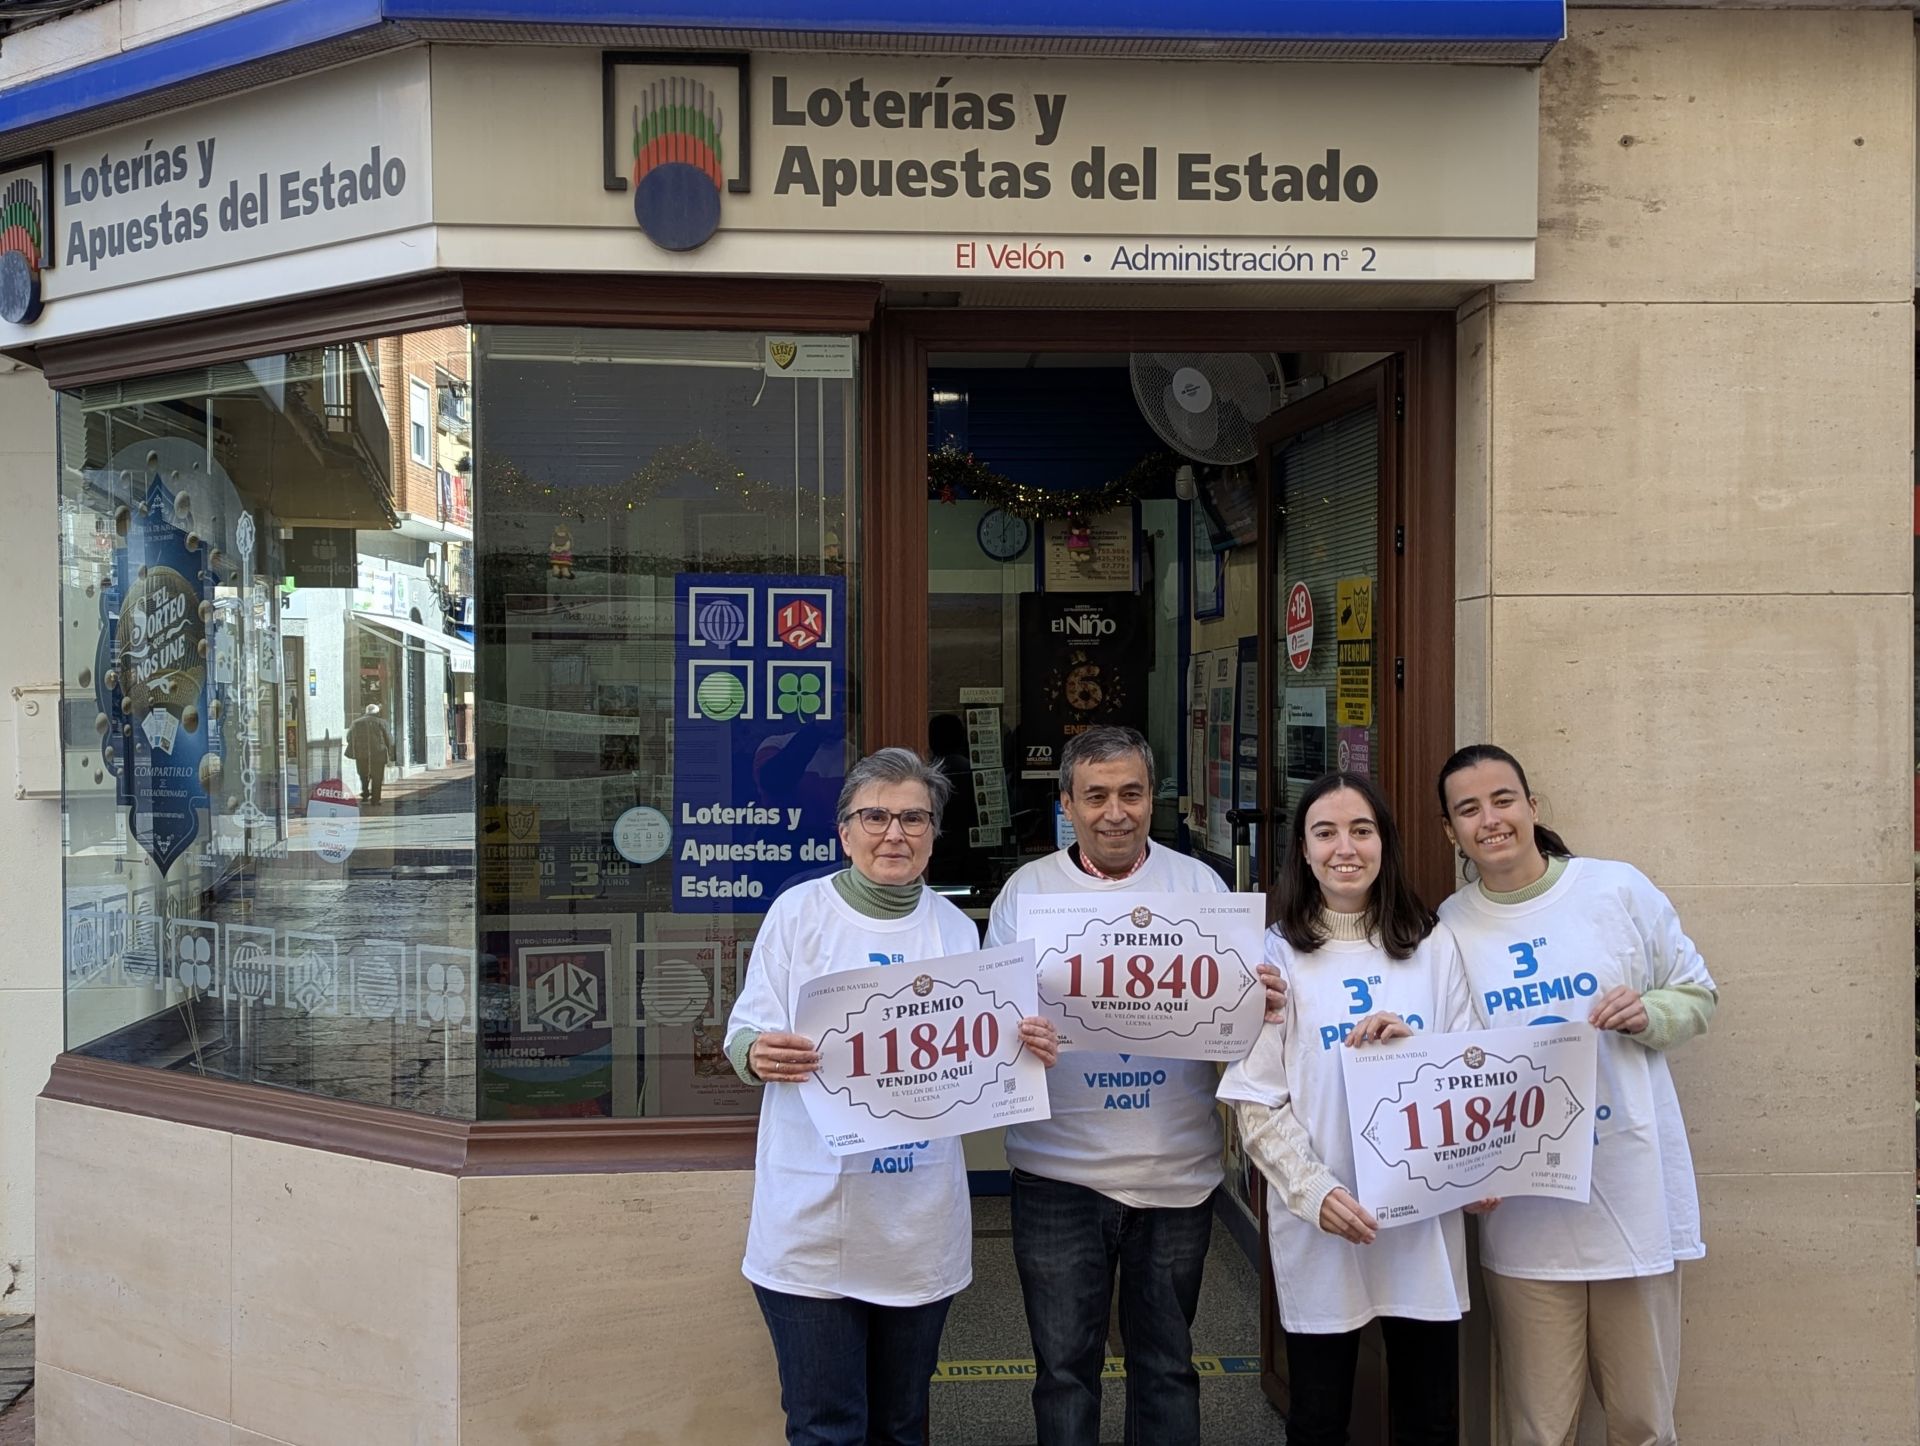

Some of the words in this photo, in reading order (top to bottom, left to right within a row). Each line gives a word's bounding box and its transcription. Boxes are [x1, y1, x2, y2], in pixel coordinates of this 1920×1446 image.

[771, 76, 1016, 130] Loterías
[1033, 94, 1067, 146] y
[63, 138, 188, 207] Loterías
[196, 136, 216, 189] y
[774, 145, 1052, 208] Apuestas
[1071, 146, 1157, 201] del
[1177, 149, 1379, 204] Estado
[65, 199, 209, 272] Apuestas
[218, 172, 269, 232] del
[279, 144, 406, 220] Estado
[956, 242, 976, 269] El
[987, 242, 1065, 270] Velón
[1110, 244, 1314, 273] Administración
[1361, 247, 1377, 272] 2
[771, 344, 793, 356] LEYSE
[152, 585, 169, 608] EL
[1291, 590, 1307, 620] +18
[130, 593, 186, 647] SORTEO
[1065, 613, 1117, 637] Niño
[136, 652, 160, 684] NOS
[159, 634, 186, 669] UNE
[1340, 642, 1370, 663] ATENCIÓN
[1026, 745, 1053, 757] 770
[134, 766, 193, 777] COMPARTIRLO
[682, 801, 780, 825] Loterías
[787, 807, 802, 831] y
[322, 849, 341, 859] TODOS
[680, 839, 792, 867] Apuestas
[799, 838, 836, 862] del
[681, 875, 763, 898] Estado
[1029, 906, 1056, 915] LOTERÍA
[1113, 933, 1183, 947] PREMIO
[995, 956, 1024, 968] DICIEMBRE
[1063, 954, 1219, 999] 11840
[807, 986, 835, 998] LOTERÍA
[836, 985, 846, 993] DE
[846, 982, 879, 991] NAVIDAD
[1484, 972, 1599, 1016] PREMIO
[896, 995, 964, 1019] PREMIO
[1091, 1001, 1151, 1011] VENDIDO
[1154, 999, 1188, 1013] AQUÍ
[493, 1048, 545, 1057] MUCHOS
[845, 1011, 999, 1078] 11840
[543, 1056, 570, 1068] MÁS
[1355, 1054, 1384, 1063] LOTERÍA
[1395, 1052, 1428, 1060] NAVIDAD
[876, 1071, 938, 1089] VENDIDO
[940, 1061, 973, 1080] AQUÍ
[1084, 1070, 1167, 1088] VENDIDO
[1448, 1070, 1518, 1090] PREMIO
[901, 1088, 924, 1096] VELÓN
[935, 1082, 960, 1092] LUCENA
[914, 1094, 940, 1103] LUCENA
[1104, 1088, 1150, 1110] AQUÍ
[1399, 1085, 1545, 1151] 11840
[836, 1132, 859, 1141] LOTERÍA
[837, 1137, 865, 1147] NACIONAL
[1434, 1142, 1487, 1162] VENDIDO
[1488, 1131, 1516, 1150] AQUÍ
[871, 1152, 914, 1174] AQUÍ
[1390, 1204, 1414, 1213] LOTERÍA
[1390, 1208, 1419, 1218] NACIONAL
